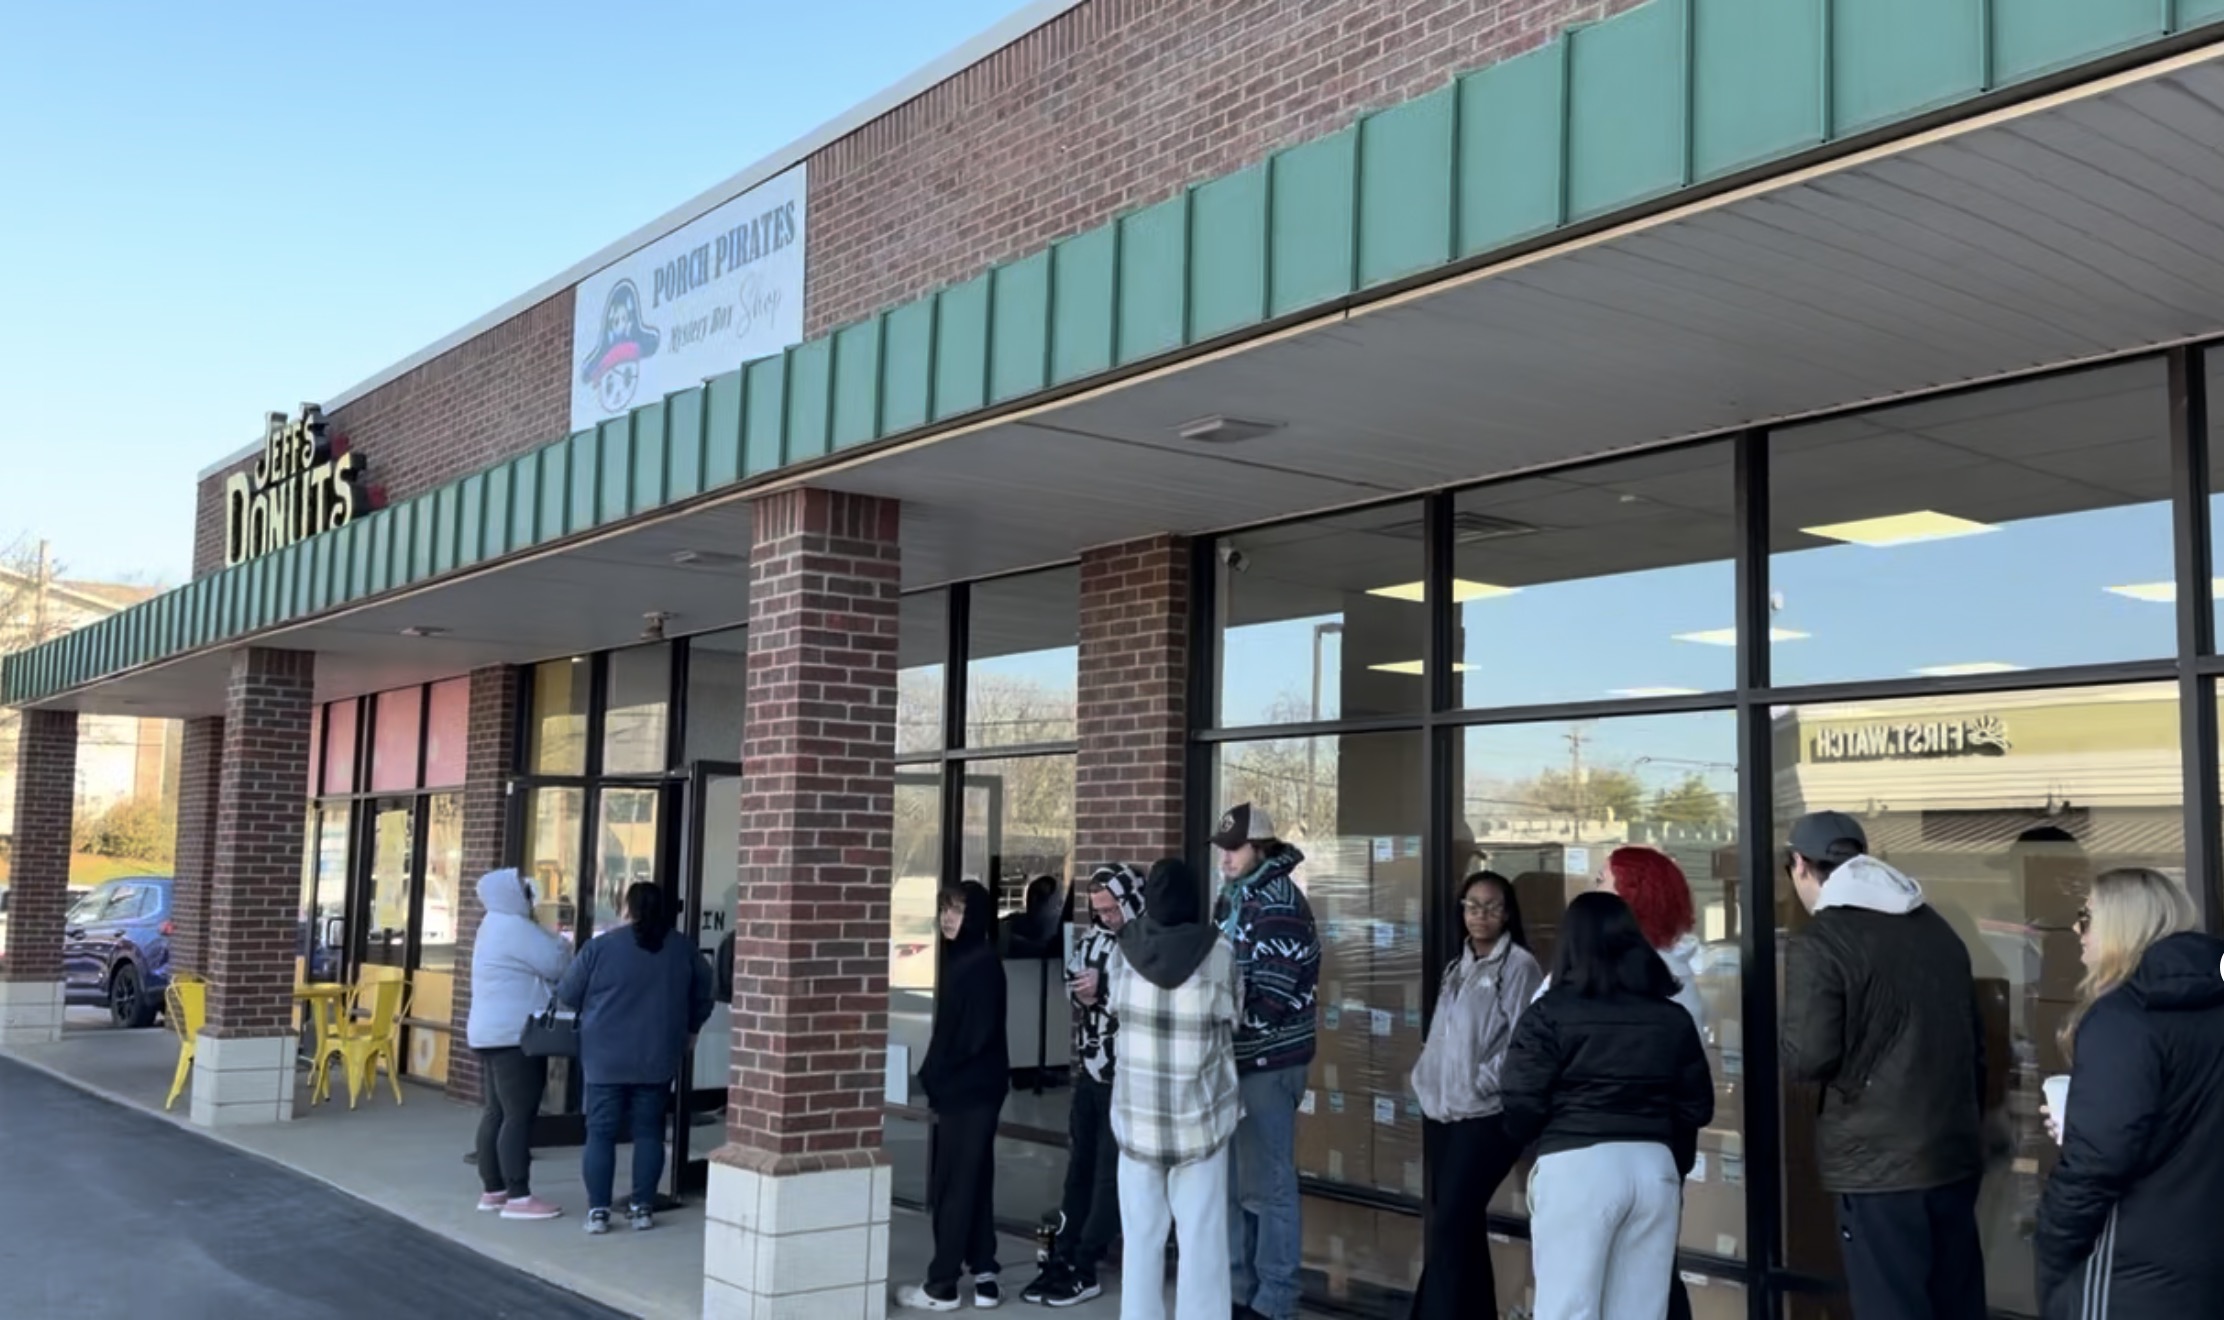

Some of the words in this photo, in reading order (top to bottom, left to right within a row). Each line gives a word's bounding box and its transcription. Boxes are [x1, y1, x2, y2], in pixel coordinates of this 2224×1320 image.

[652, 242, 711, 309] PORCH
[714, 199, 796, 280] PIRATES
[225, 451, 353, 569] DONUTS
[702, 910, 726, 931] IN
